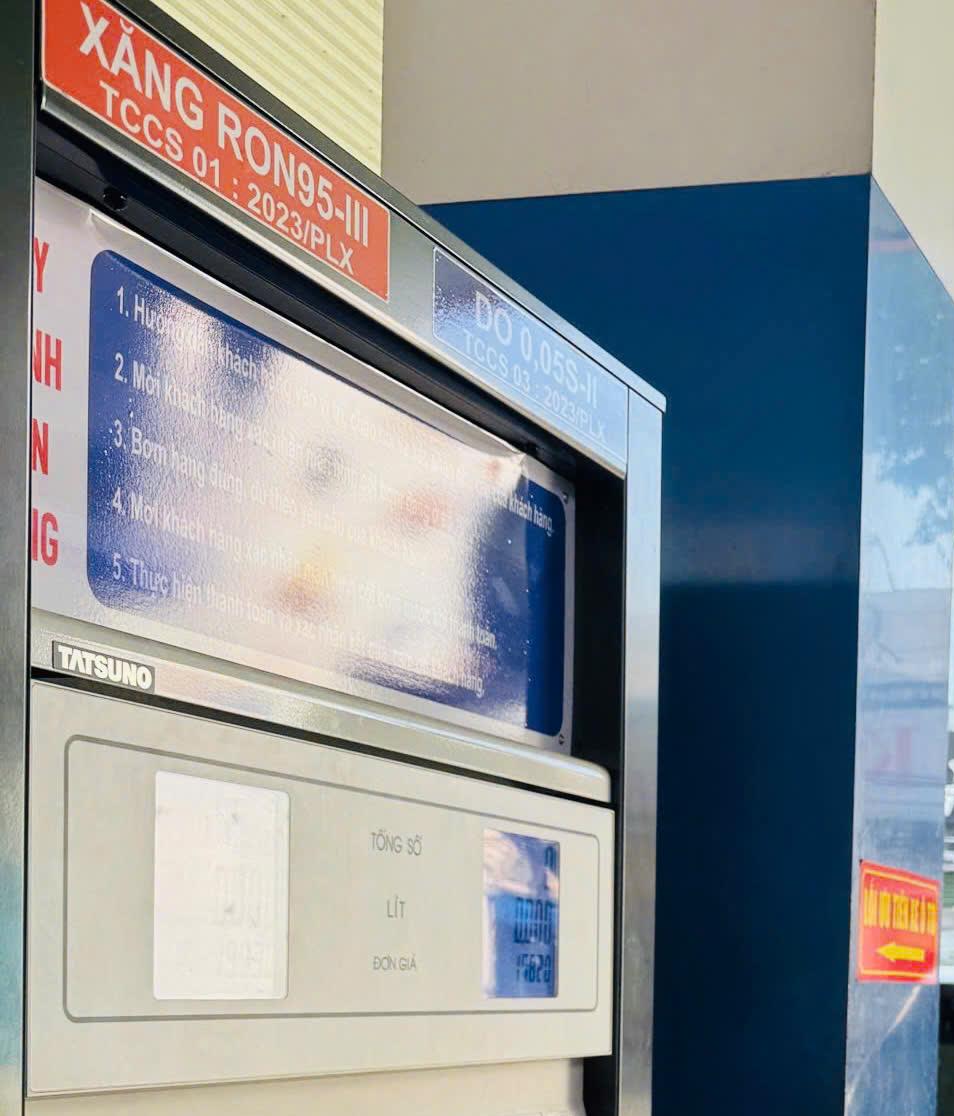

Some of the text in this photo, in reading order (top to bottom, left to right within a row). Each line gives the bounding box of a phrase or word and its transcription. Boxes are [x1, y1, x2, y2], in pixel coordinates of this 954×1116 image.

[80, 4, 369, 248] XĂNG RON95-III
[100, 80, 184, 162] TCCS
[192, 147, 221, 188] 01
[247, 183, 355, 275] 2023/PLX
[475, 291, 513, 345] DO
[463, 328, 508, 378] TCCS
[58, 644, 152, 690] TATSUNO
